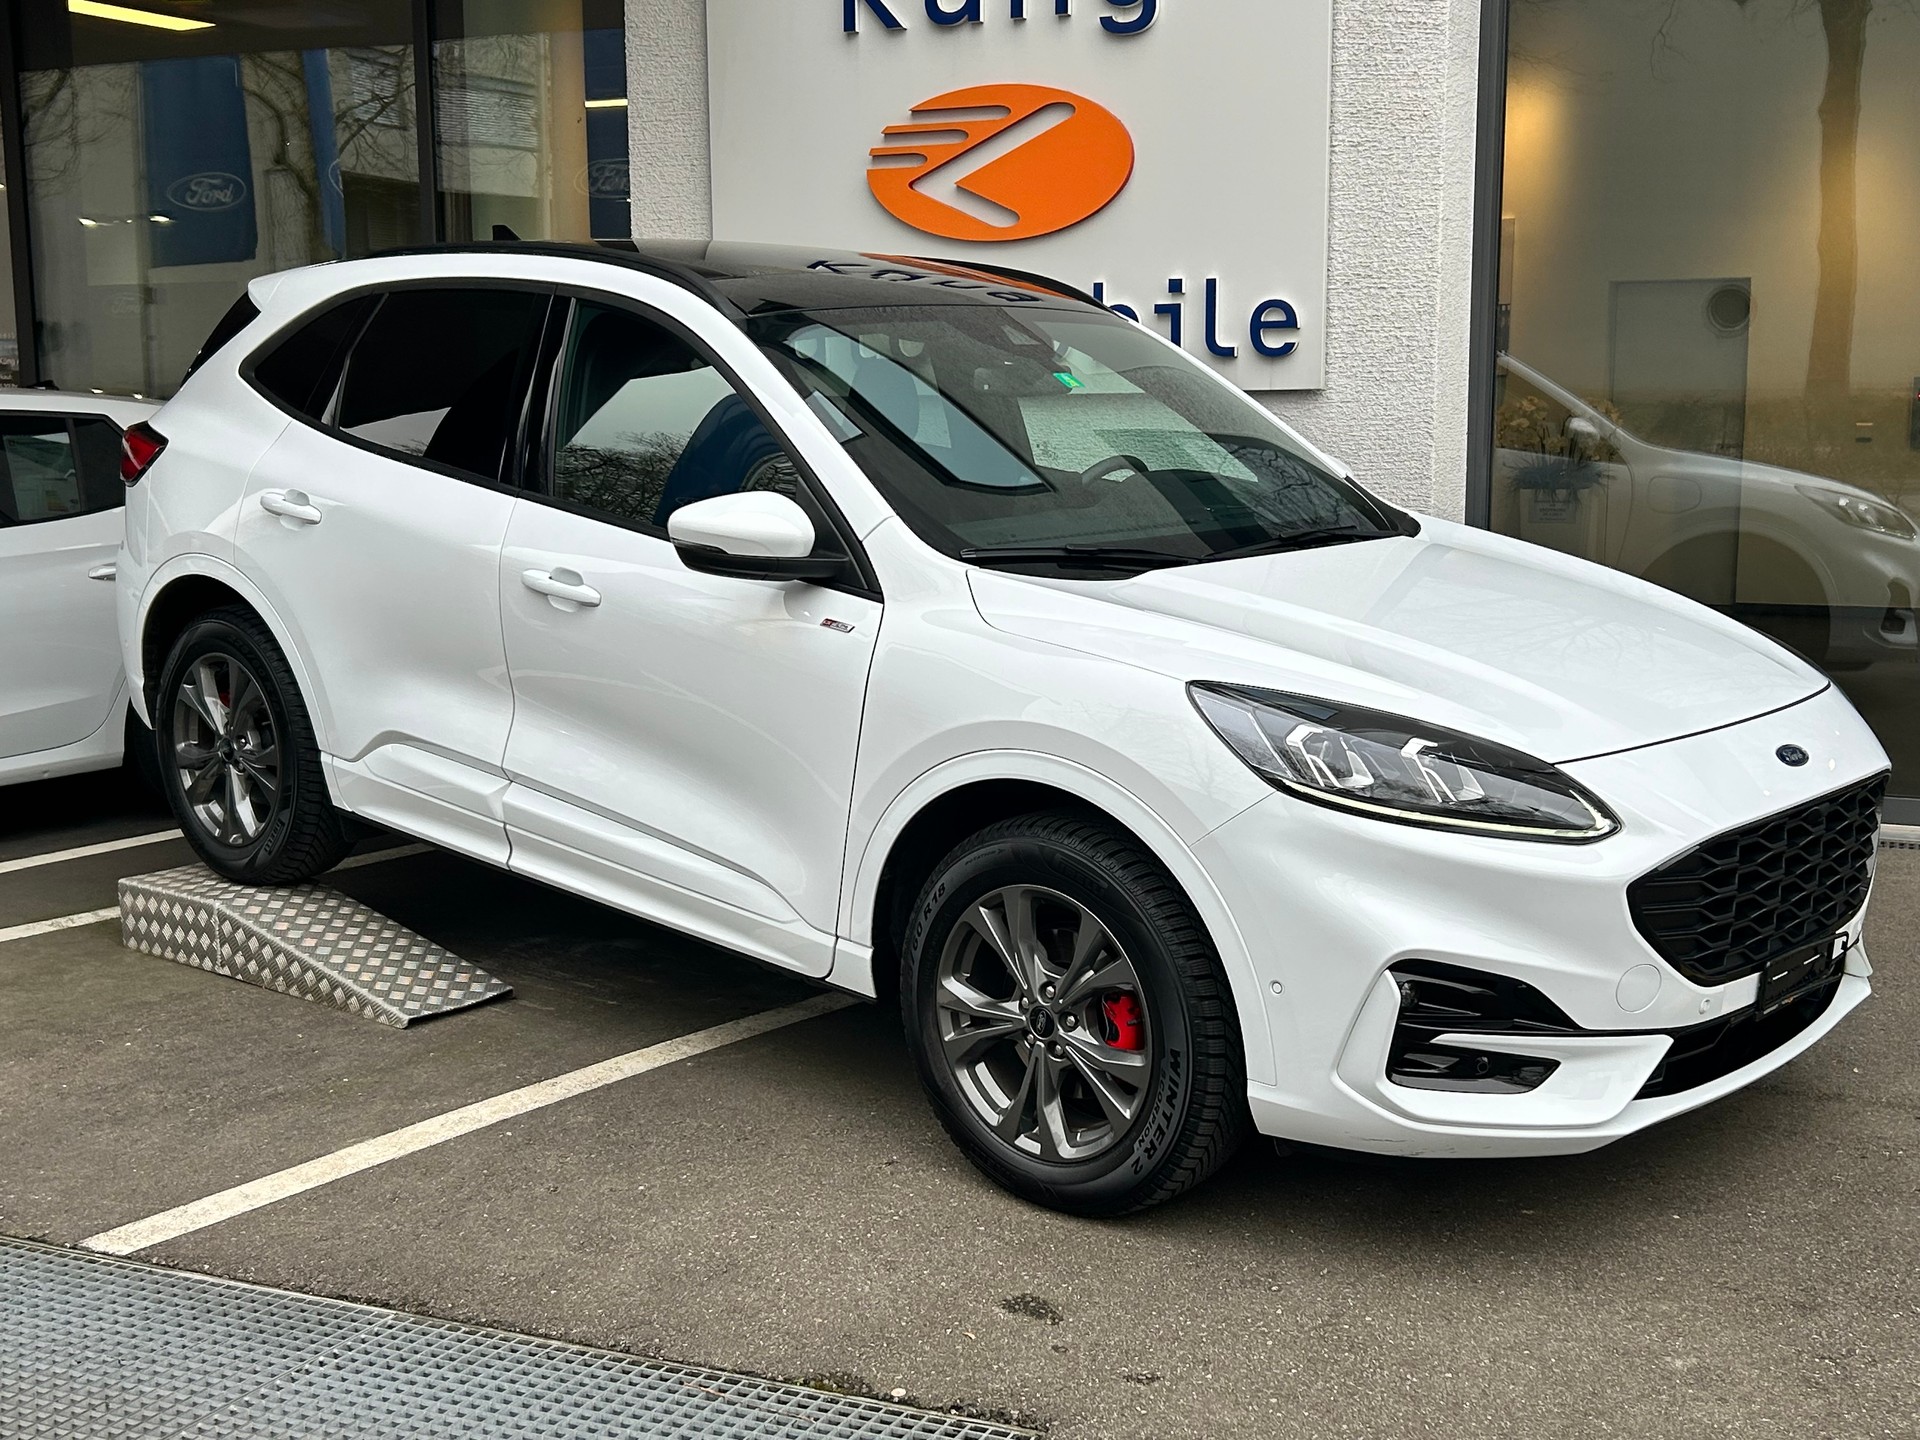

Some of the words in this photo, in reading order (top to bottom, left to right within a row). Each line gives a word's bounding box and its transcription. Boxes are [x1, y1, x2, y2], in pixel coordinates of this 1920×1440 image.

[185, 177, 234, 205] Ford
[923, 882, 946, 921] R18
[1138, 1070, 1166, 1147] SCORPION
[1143, 1048, 1182, 1161] WINTER
[1131, 1156, 1144, 1175] 2
